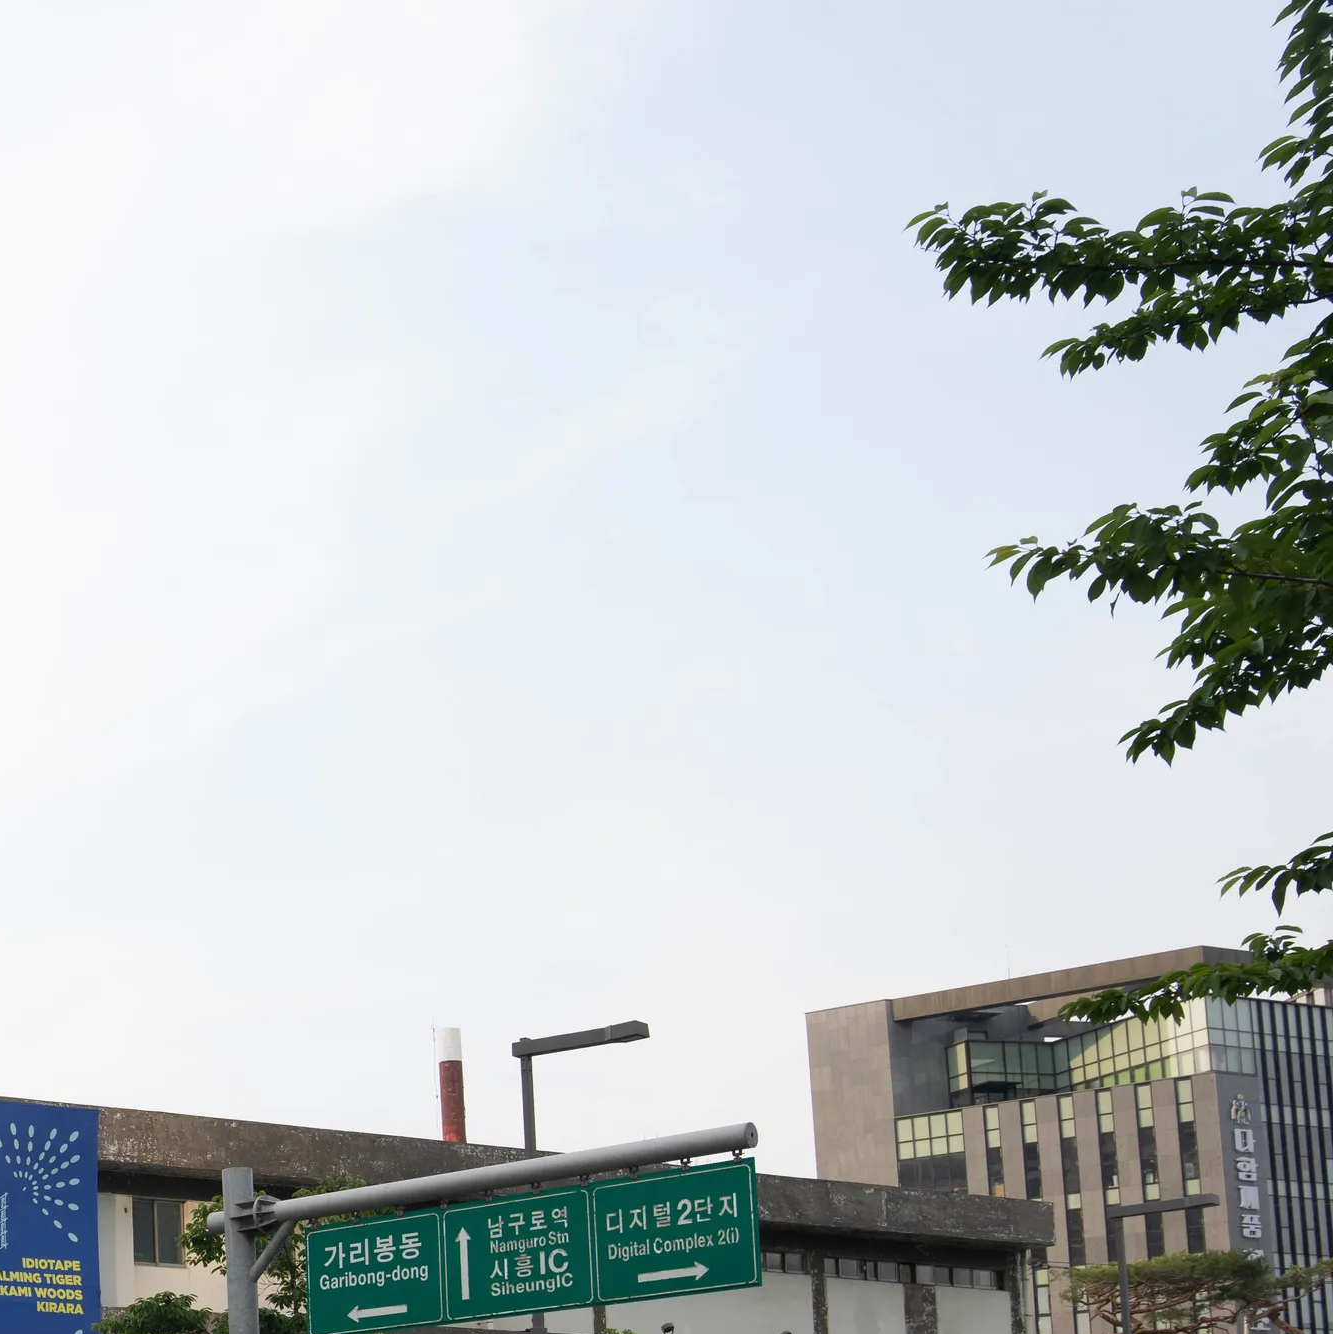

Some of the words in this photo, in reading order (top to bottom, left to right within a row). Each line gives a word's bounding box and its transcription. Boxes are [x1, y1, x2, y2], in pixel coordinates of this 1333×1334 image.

[487, 1207, 568, 1239] 남구로역
[324, 1232, 422, 1270] 가리봉동
[489, 1234, 545, 1255] Namguro
[548, 1231, 569, 1245] Stn
[608, 1240, 650, 1261] Digital
[653, 1232, 714, 1255] Complex
[22, 1257, 81, 1271] IDIOTAPE
[490, 1248, 569, 1281] 시흥IC
[44, 1273, 82, 1286] TIGER
[319, 1264, 429, 1291] Garibong-dong
[34, 1287, 84, 1301] WOODS
[36, 1301, 84, 1315] KIRARA
